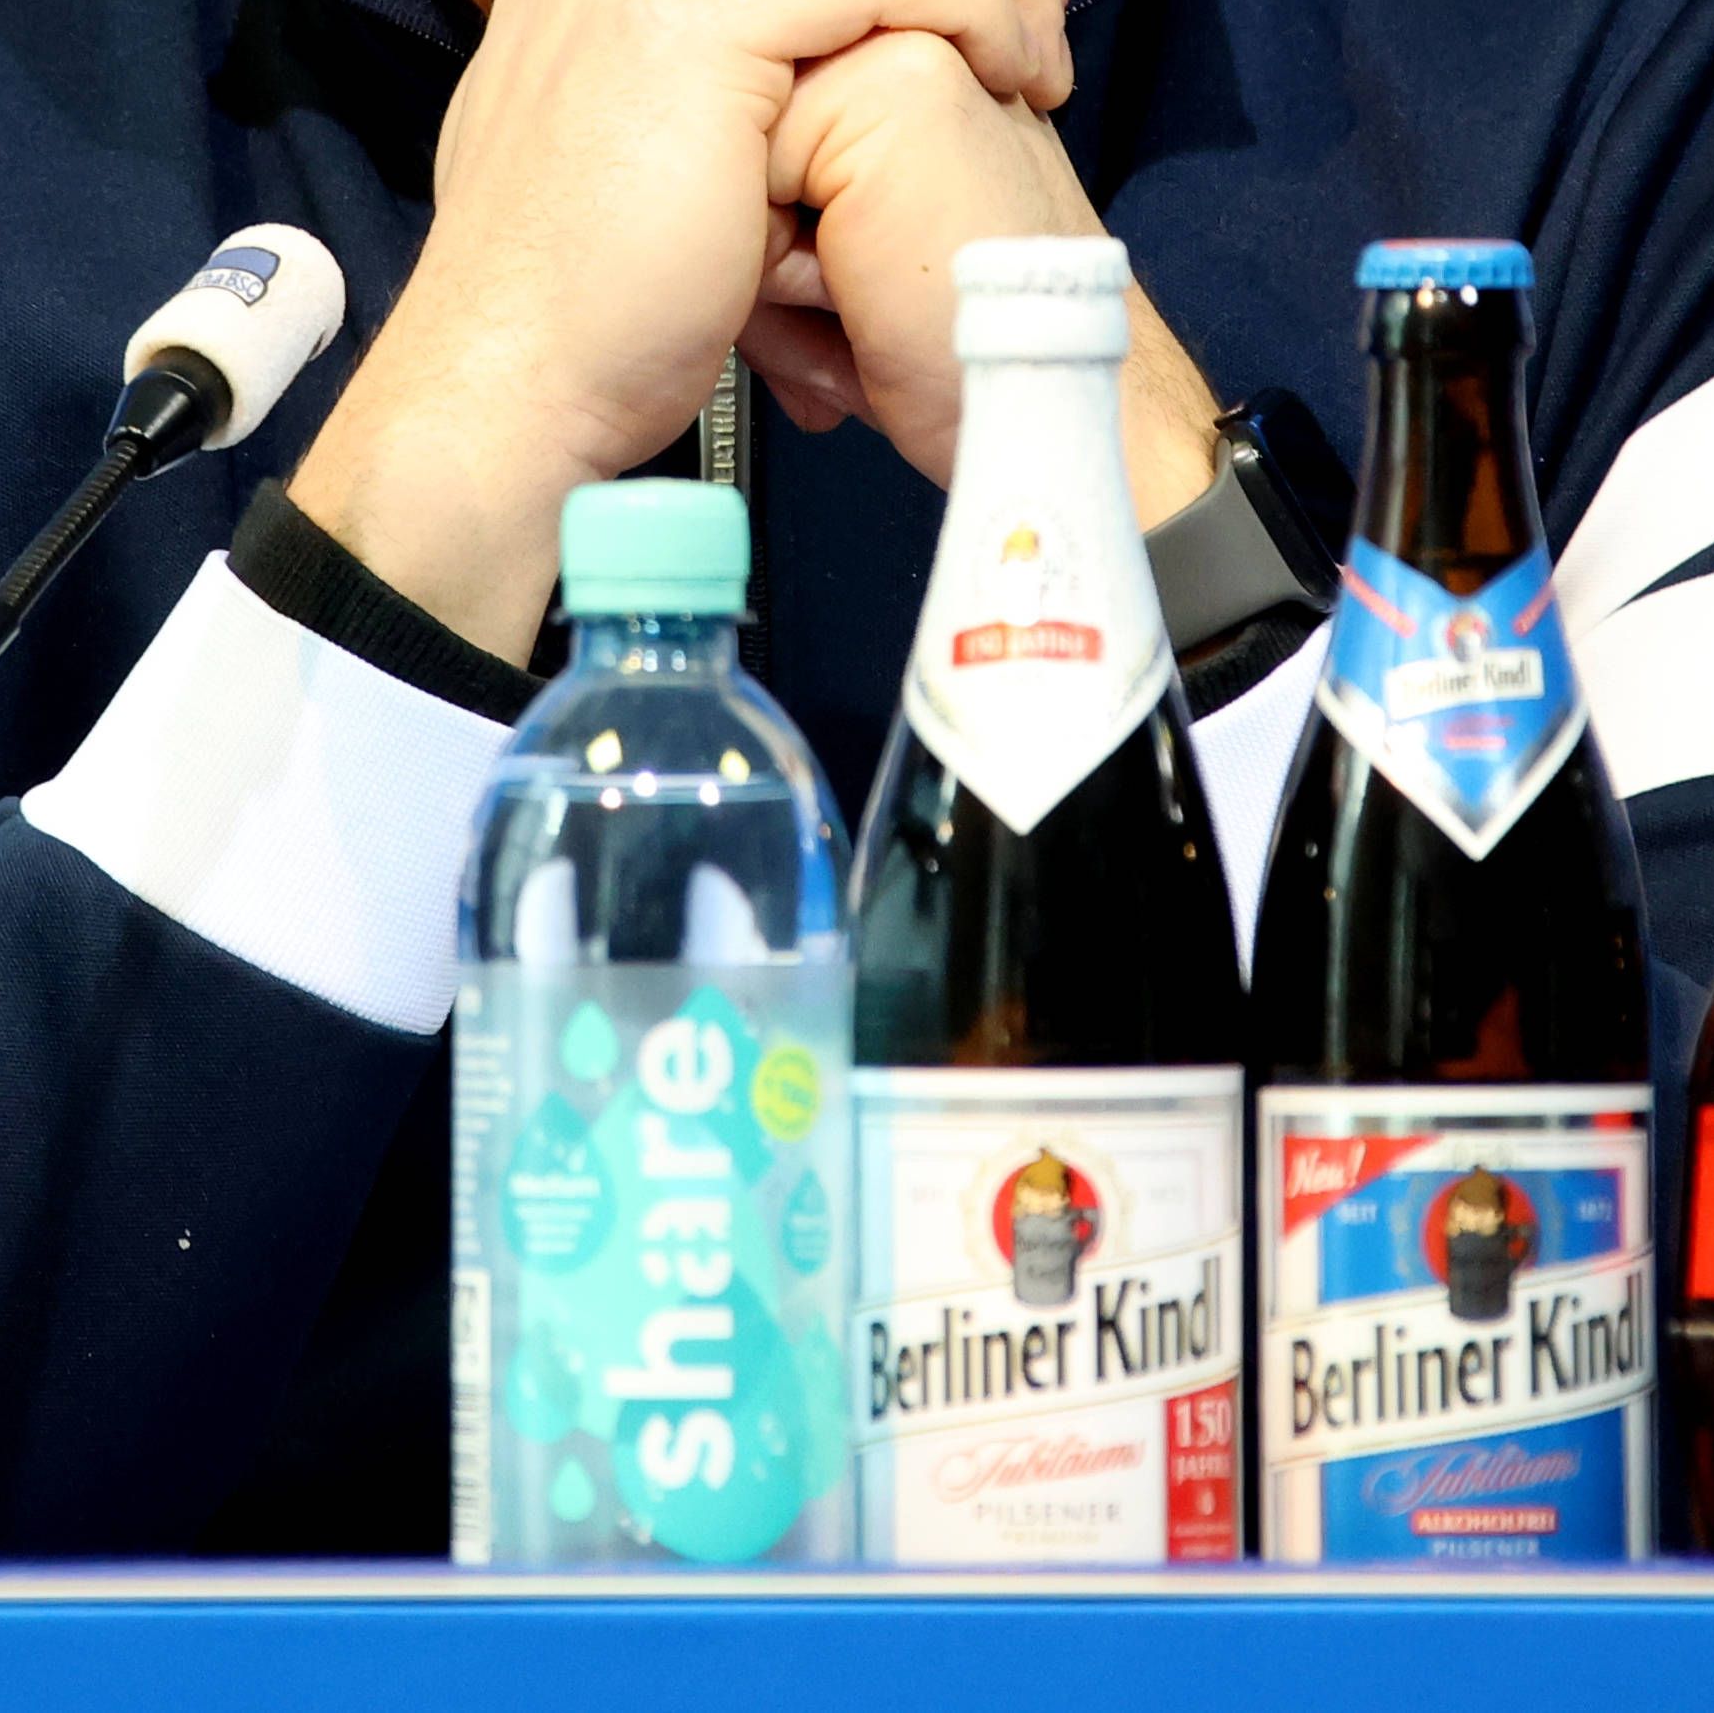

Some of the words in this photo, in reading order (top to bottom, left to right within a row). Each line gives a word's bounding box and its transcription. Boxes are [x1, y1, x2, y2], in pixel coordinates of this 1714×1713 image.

[603, 1016, 735, 1491] share
[1286, 1140, 1367, 1199] Neu!
[868, 1306, 1077, 1423] Berliner
[1095, 1255, 1223, 1383] Kindl
[1291, 1323, 1513, 1441] Berliner
[1529, 1271, 1645, 1400] Kindl
[1174, 1398, 1232, 1450] 150
